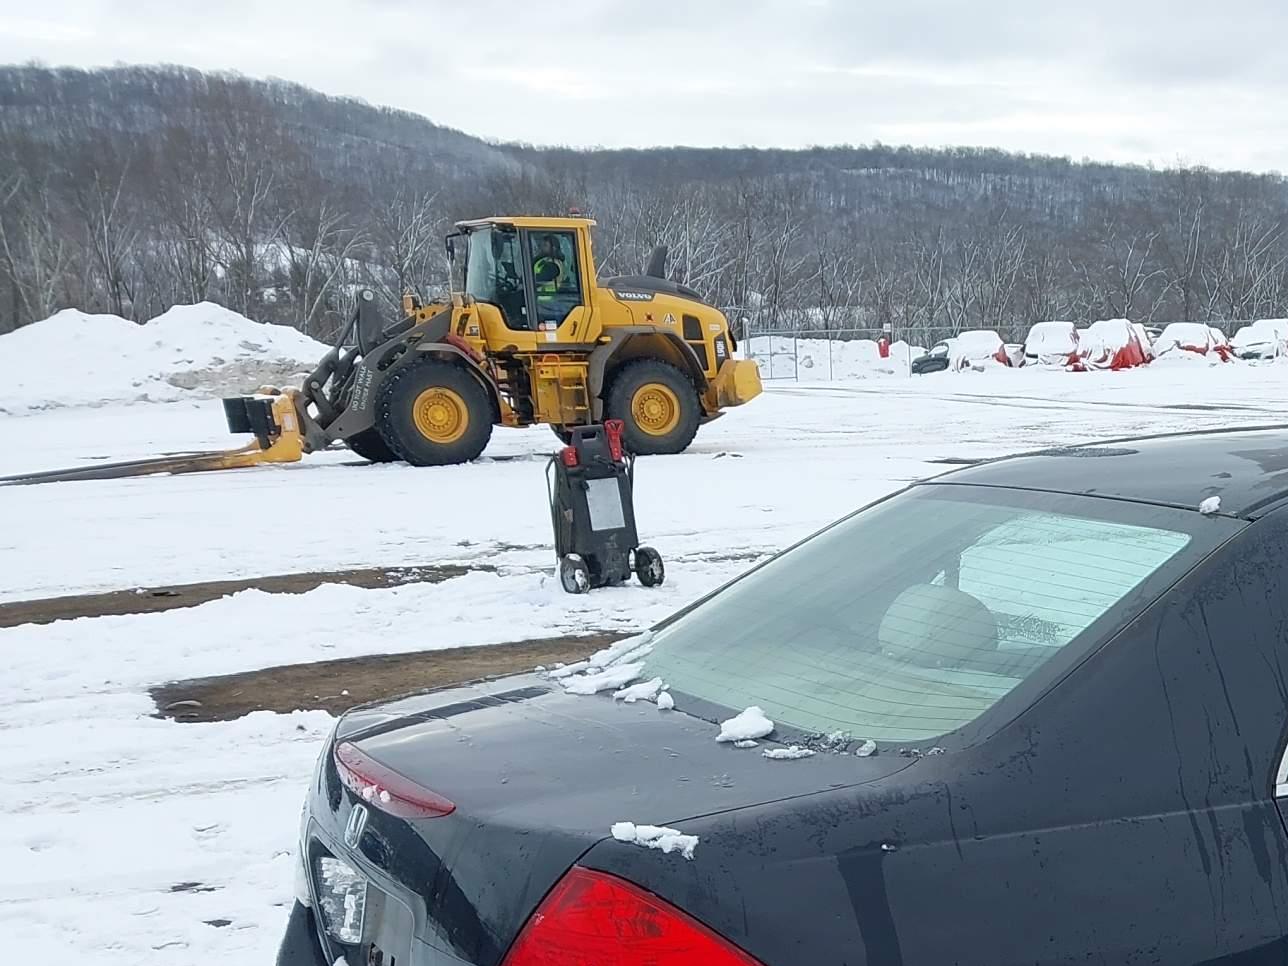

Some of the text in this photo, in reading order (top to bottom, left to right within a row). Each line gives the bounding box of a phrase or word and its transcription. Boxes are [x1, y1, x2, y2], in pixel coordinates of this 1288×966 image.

[617, 292, 652, 300] VOLVO
[357, 365, 366, 384] WALK
[365, 369, 373, 387] MAST
